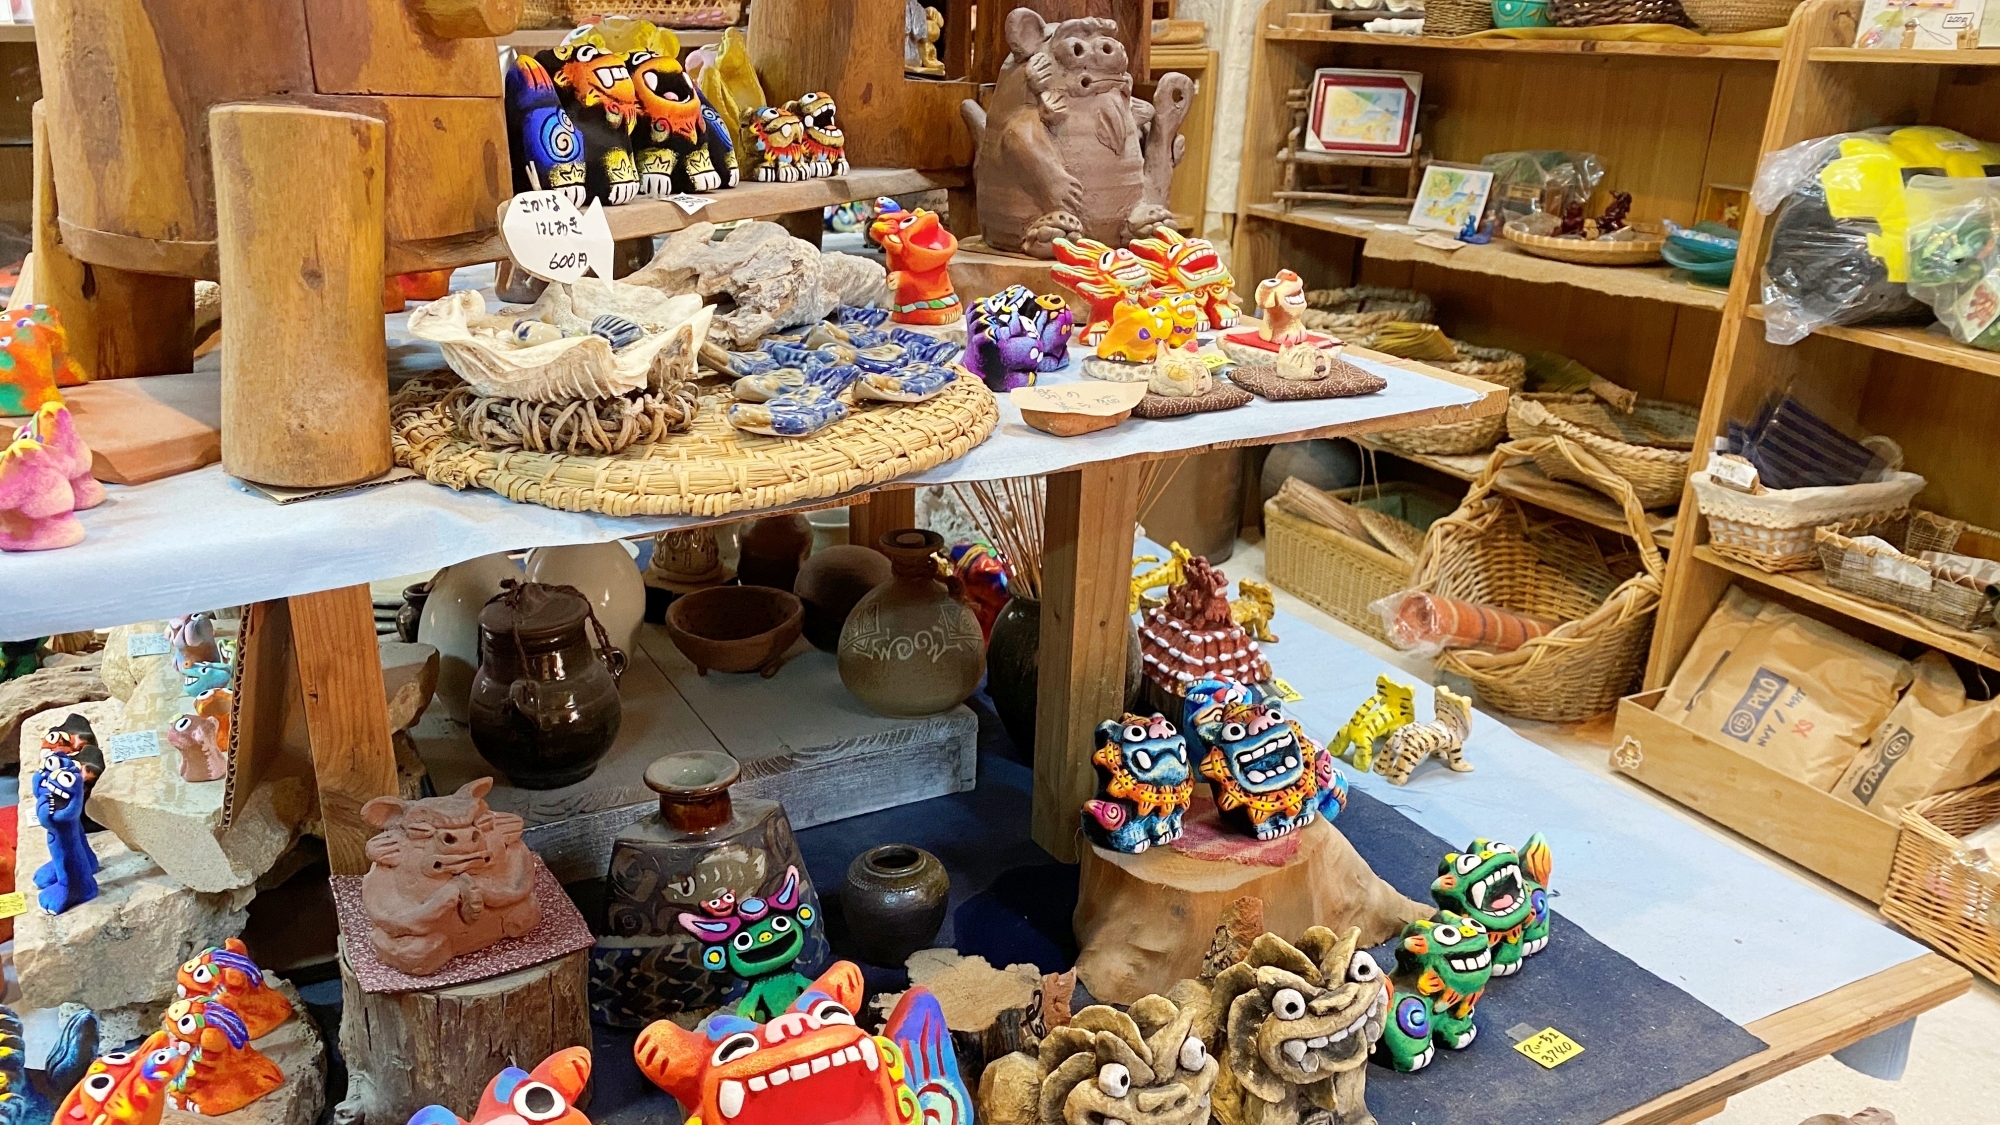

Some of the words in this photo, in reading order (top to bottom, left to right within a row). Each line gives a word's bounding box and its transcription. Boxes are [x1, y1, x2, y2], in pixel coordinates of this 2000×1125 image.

[519, 194, 561, 214] さかな
[549, 252, 588, 270] 600円
[1747, 678, 1779, 710] POLO
[1756, 724, 1777, 748] NVY
[1792, 719, 1814, 738] XS
[1541, 1041, 1572, 1063] 3740
